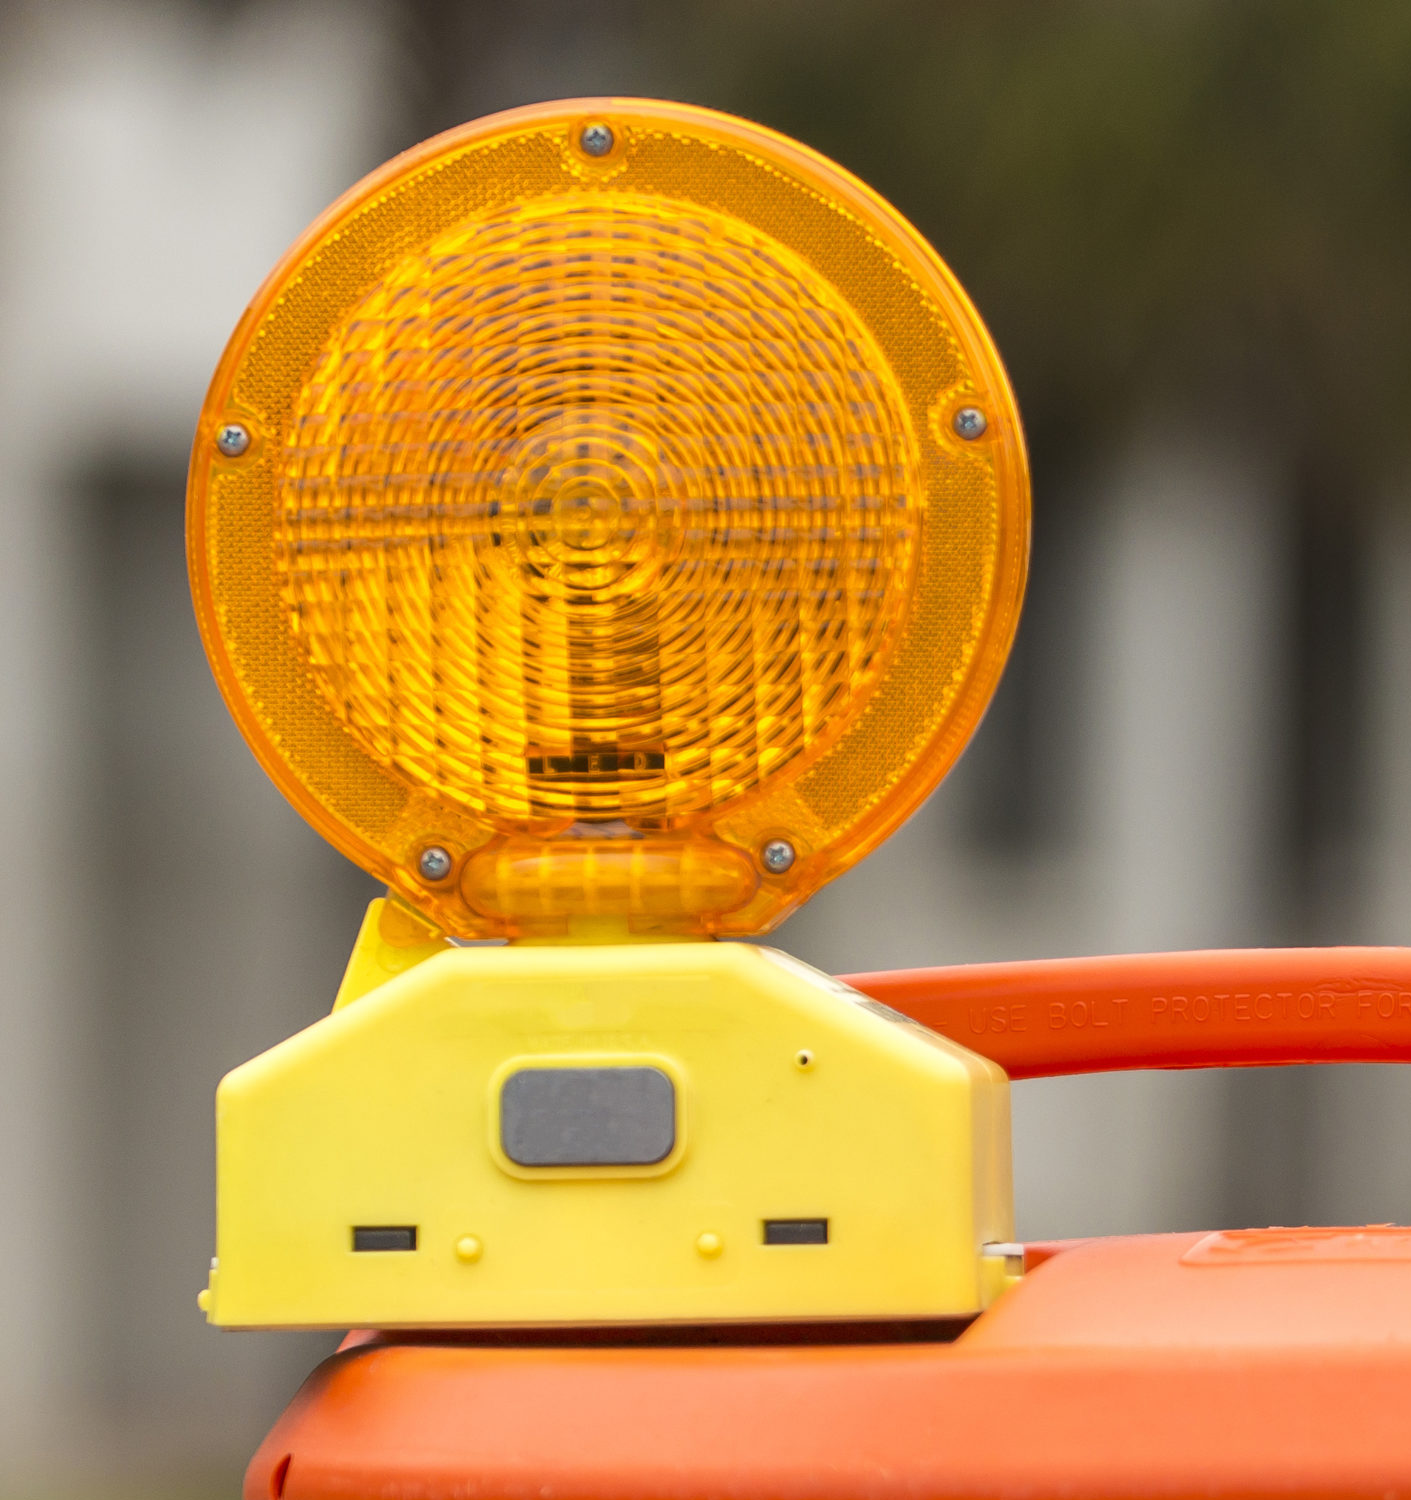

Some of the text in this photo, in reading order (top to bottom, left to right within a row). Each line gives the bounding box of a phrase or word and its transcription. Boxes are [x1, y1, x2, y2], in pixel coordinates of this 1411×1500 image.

[542, 751, 648, 776] LED
[967, 1003, 1028, 1035] USE
[1048, 998, 1129, 1030] BOLT
[1150, 991, 1337, 1023] PROTECTOR
